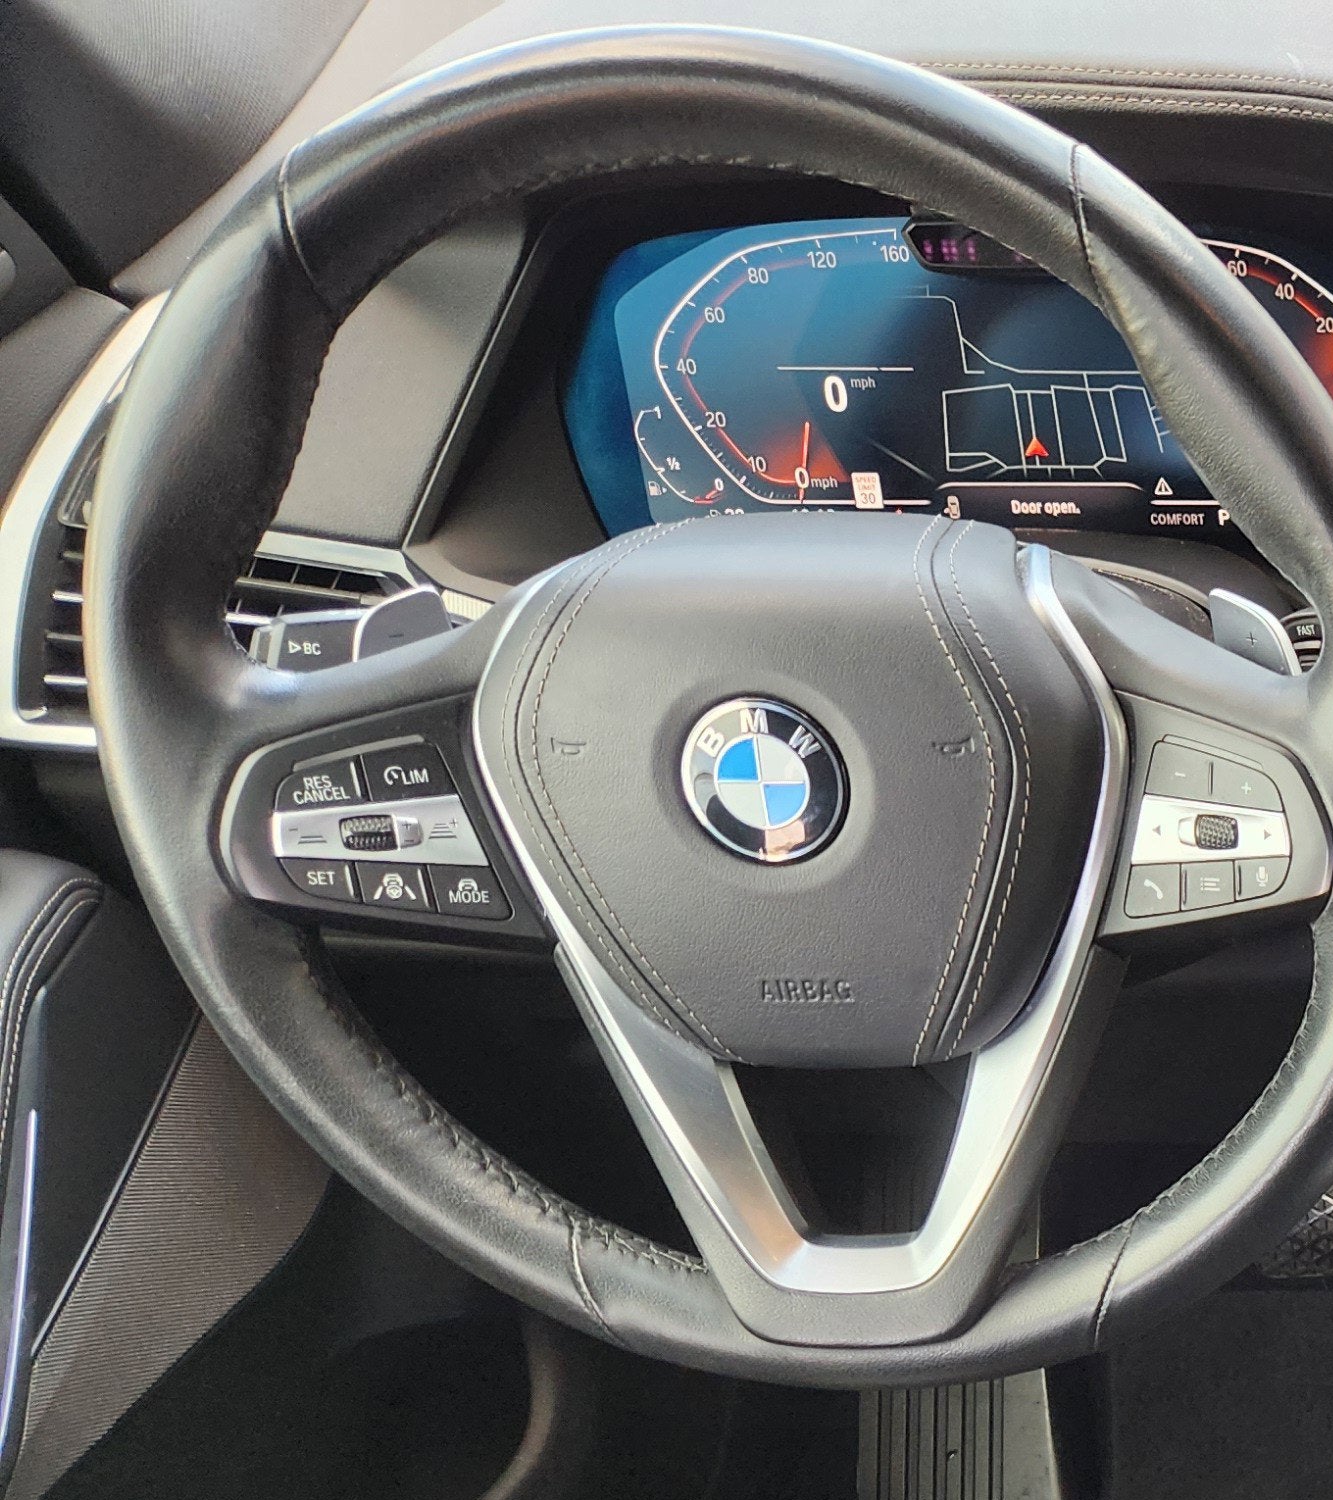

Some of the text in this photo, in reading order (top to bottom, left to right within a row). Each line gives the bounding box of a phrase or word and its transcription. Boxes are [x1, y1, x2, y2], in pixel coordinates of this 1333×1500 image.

[807, 251, 837, 269] 120
[880, 245, 910, 263] 160
[747, 267, 769, 284] 80
[1227, 260, 1248, 277] 60
[1275, 283, 1295, 300] 40
[704, 307, 725, 324] 60
[677, 358, 697, 375] 40
[823, 375, 876, 413] 0 mph
[705, 411, 727, 428] 20
[748, 456, 767, 473] 10
[715, 478, 724, 492] 0
[860, 492, 876, 504] 30
[1011, 500, 1081, 517] Door open.
[1150, 513, 1205, 526] COMFORT
[1217, 509, 1230, 526] P
[1296, 624, 1316, 636] FAST
[302, 643, 321, 655] BC
[696, 707, 822, 759] BMW
[303, 775, 332, 790] RES
[401, 768, 429, 785] LIM
[293, 787, 350, 805] CANCEL
[306, 871, 335, 886] SET
[449, 890, 490, 903] MODE
[761, 979, 855, 1003] AIRBAG
